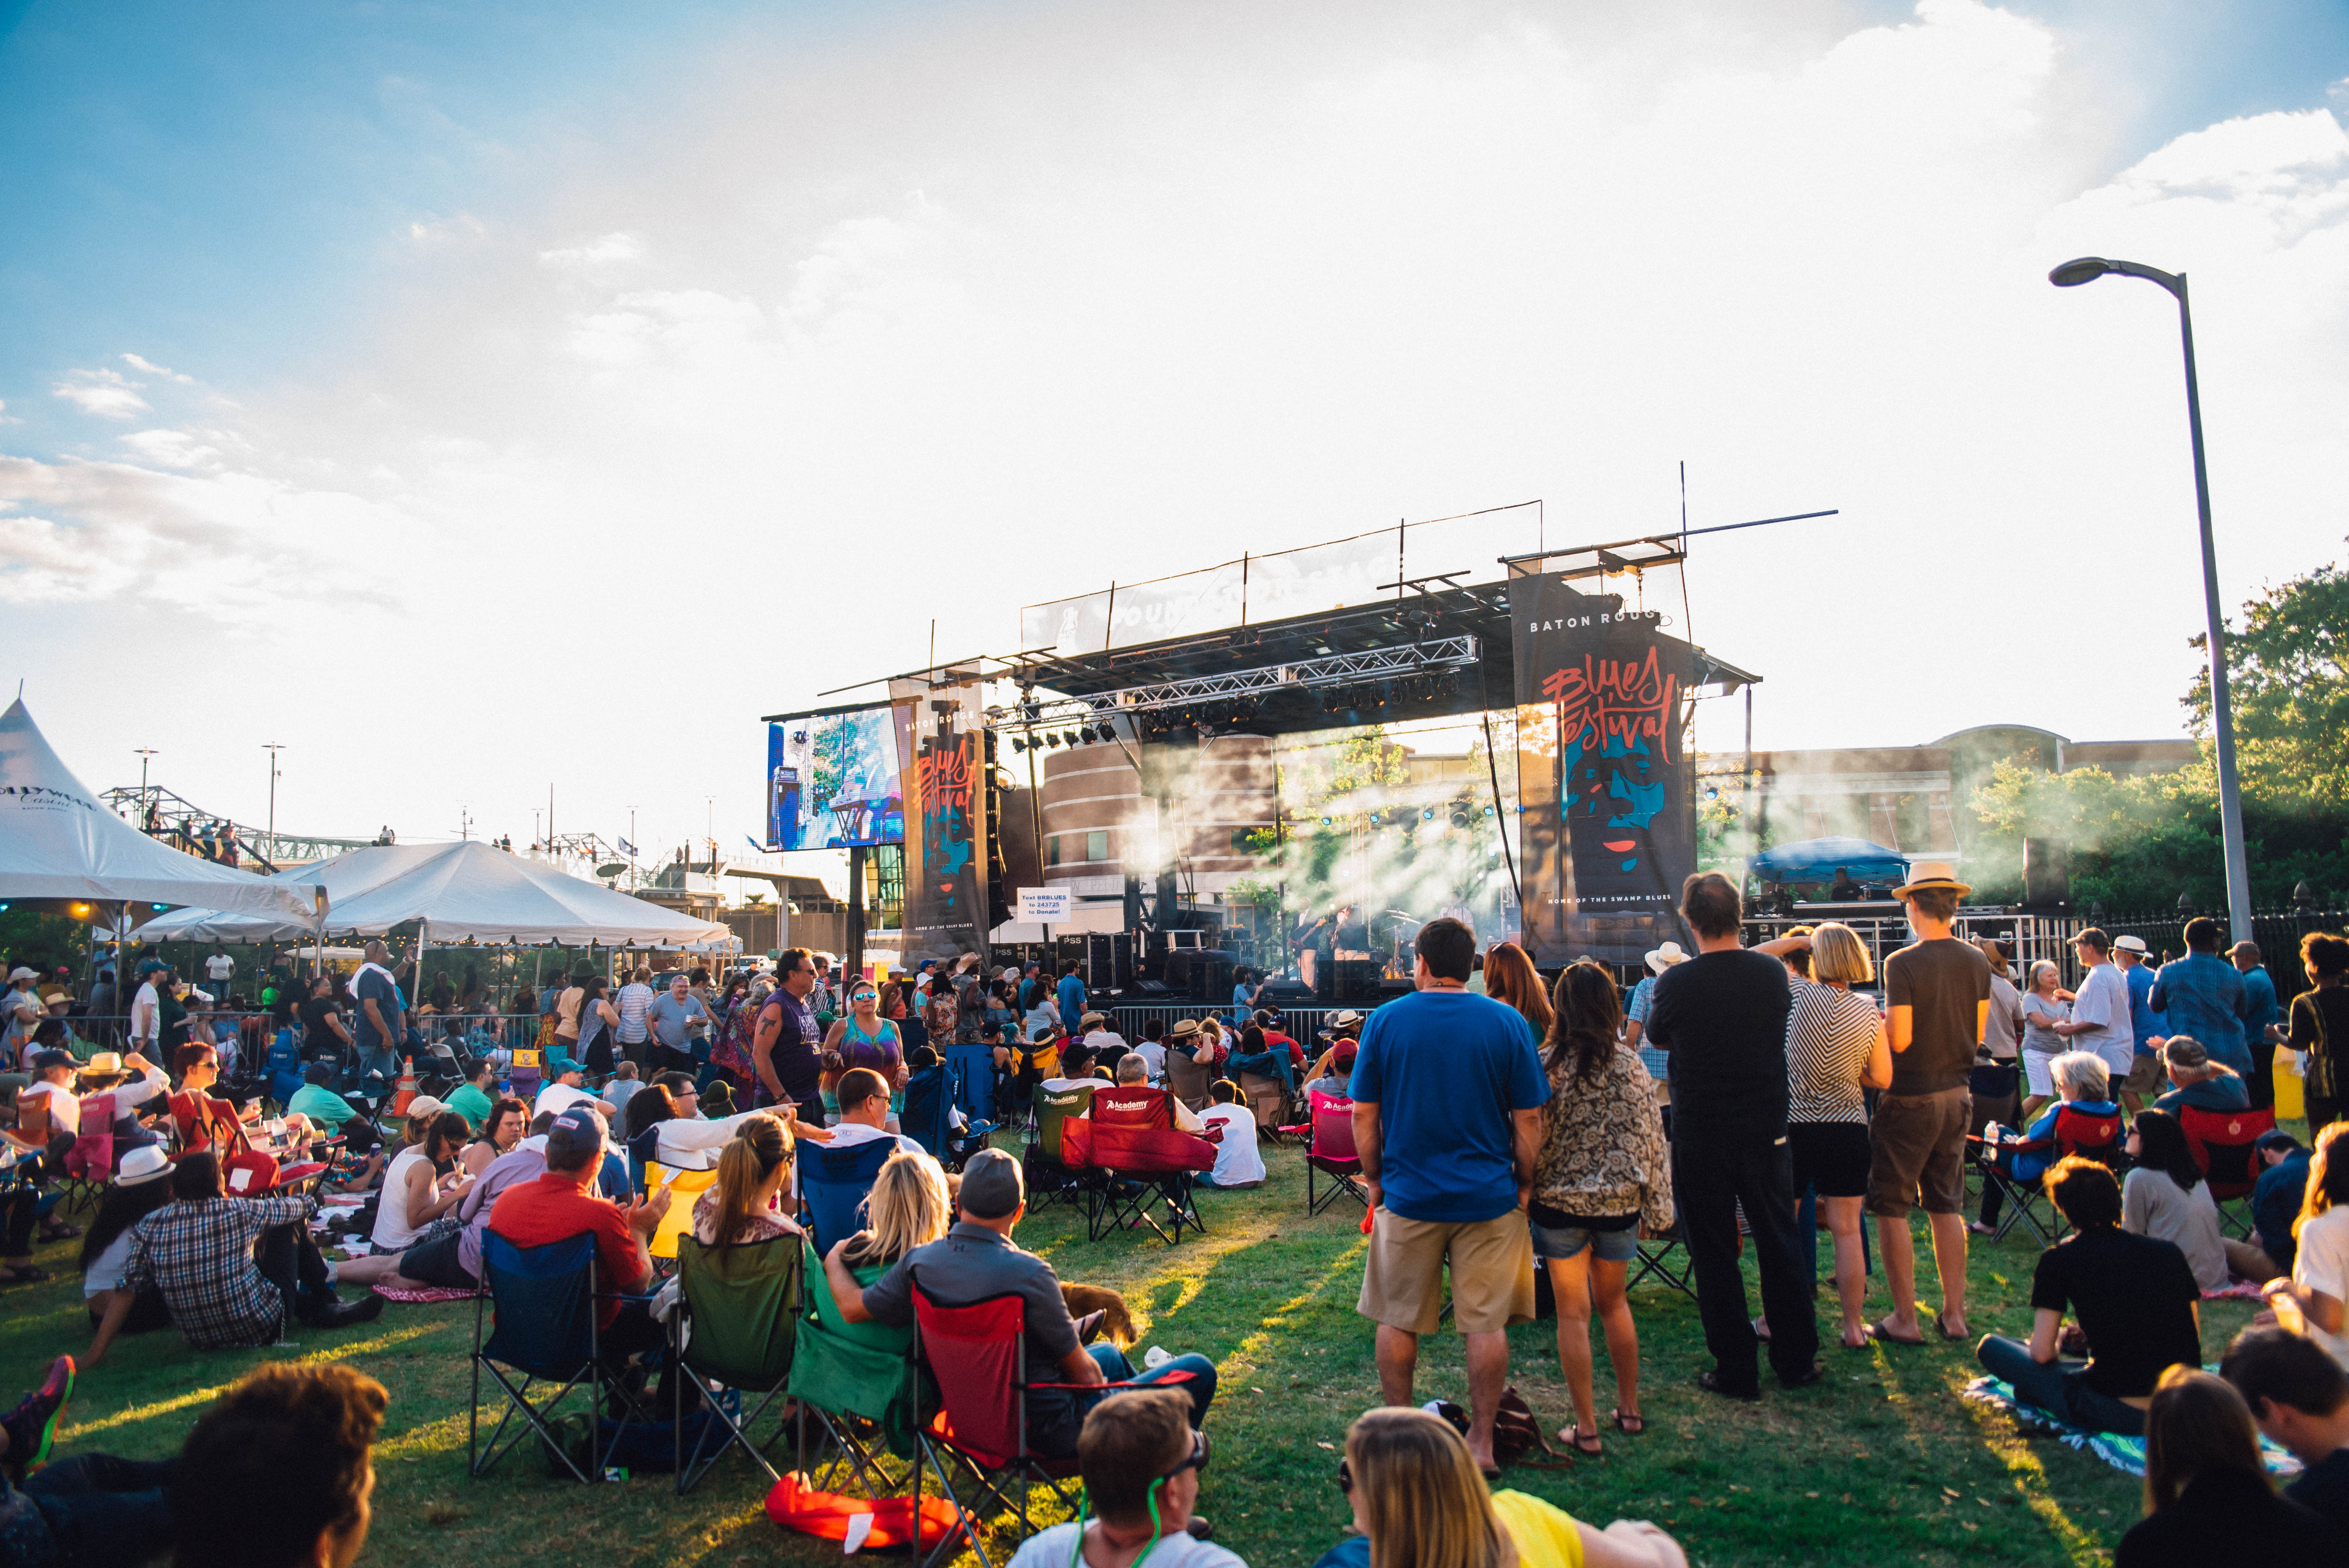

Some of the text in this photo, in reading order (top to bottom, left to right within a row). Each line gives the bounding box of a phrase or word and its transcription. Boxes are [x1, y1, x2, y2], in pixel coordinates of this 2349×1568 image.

[1530, 612, 1655, 632] BATON ROUG
[1542, 646, 1662, 704] Blues
[905, 711, 974, 732] BATON ROUGE
[1050, 1095, 1078, 1103] Academy
[1115, 1101, 1147, 1109] Academy
